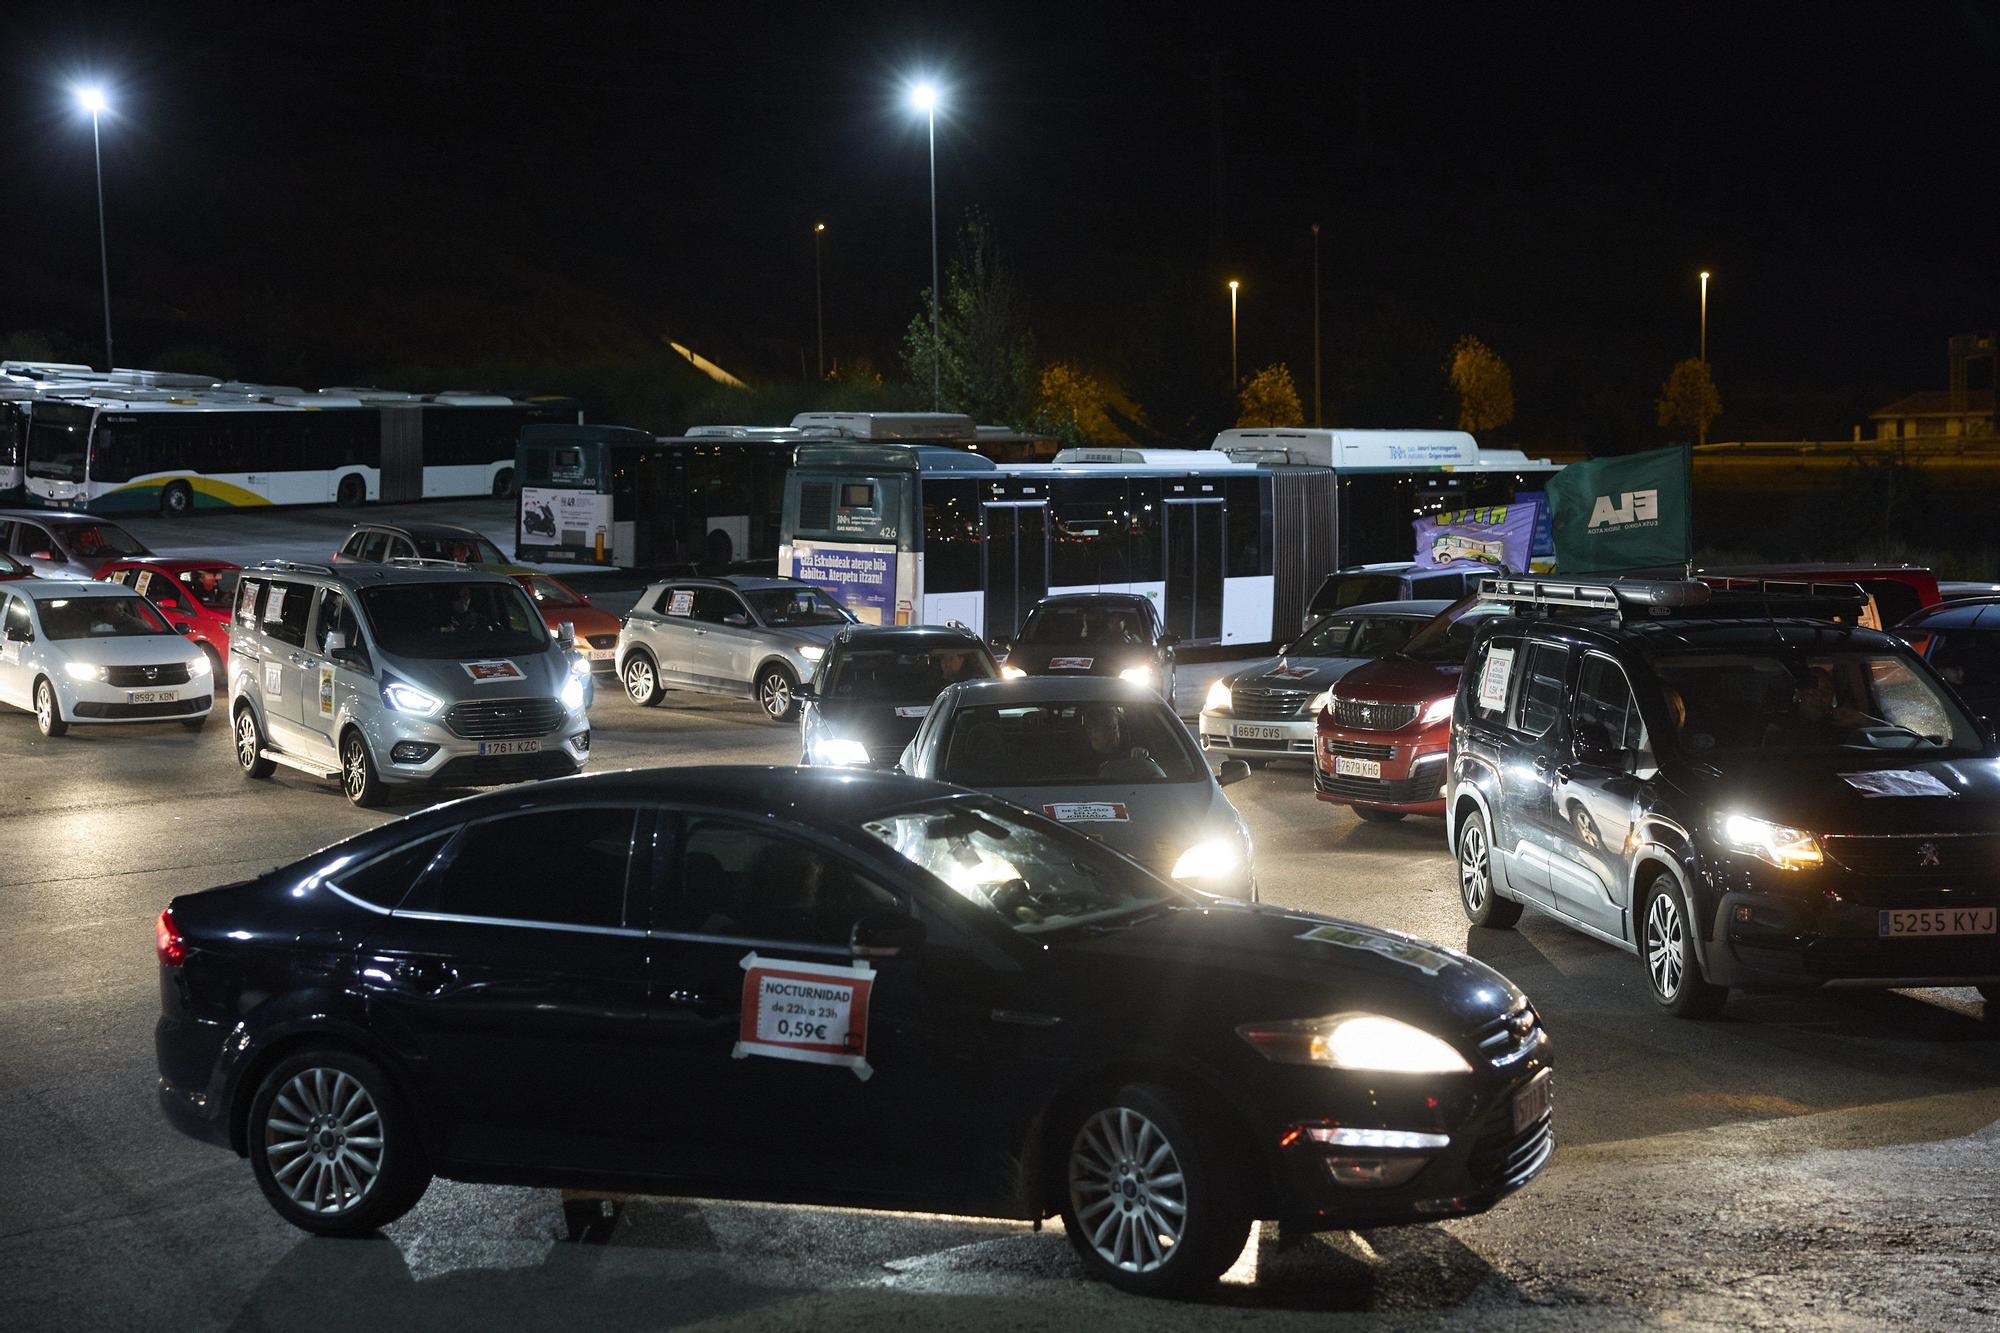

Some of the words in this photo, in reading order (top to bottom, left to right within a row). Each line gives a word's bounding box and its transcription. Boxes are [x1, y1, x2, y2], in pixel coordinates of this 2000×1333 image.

[880, 527, 896, 538] 426
[814, 555, 850, 569] Eskubideak
[851, 558, 872, 572] aterpe
[873, 557, 887, 571] bila
[800, 566, 827, 580] dabiltza.
[829, 569, 858, 584] Aterpetu
[859, 570, 882, 584] itzazu!
[135, 693, 155, 703] 8592
[1238, 727, 1260, 738] 8697
[1262, 728, 1280, 739] GVS
[488, 743, 513, 754] 1761
[517, 741, 537, 752] KZC
[1341, 760, 1361, 774] 7679
[1362, 763, 1379, 776] KHG
[1893, 914, 1946, 932] 5255
[1954, 911, 1993, 931] KYJ
[765, 983, 850, 1003] NOCTURNIDAD
[771, 1002, 783, 1013] de
[787, 1003, 807, 1015] 22h
[808, 1009, 816, 1017] a
[818, 1007, 838, 1019] 23h
[777, 1019, 827, 1040] 0,59€
